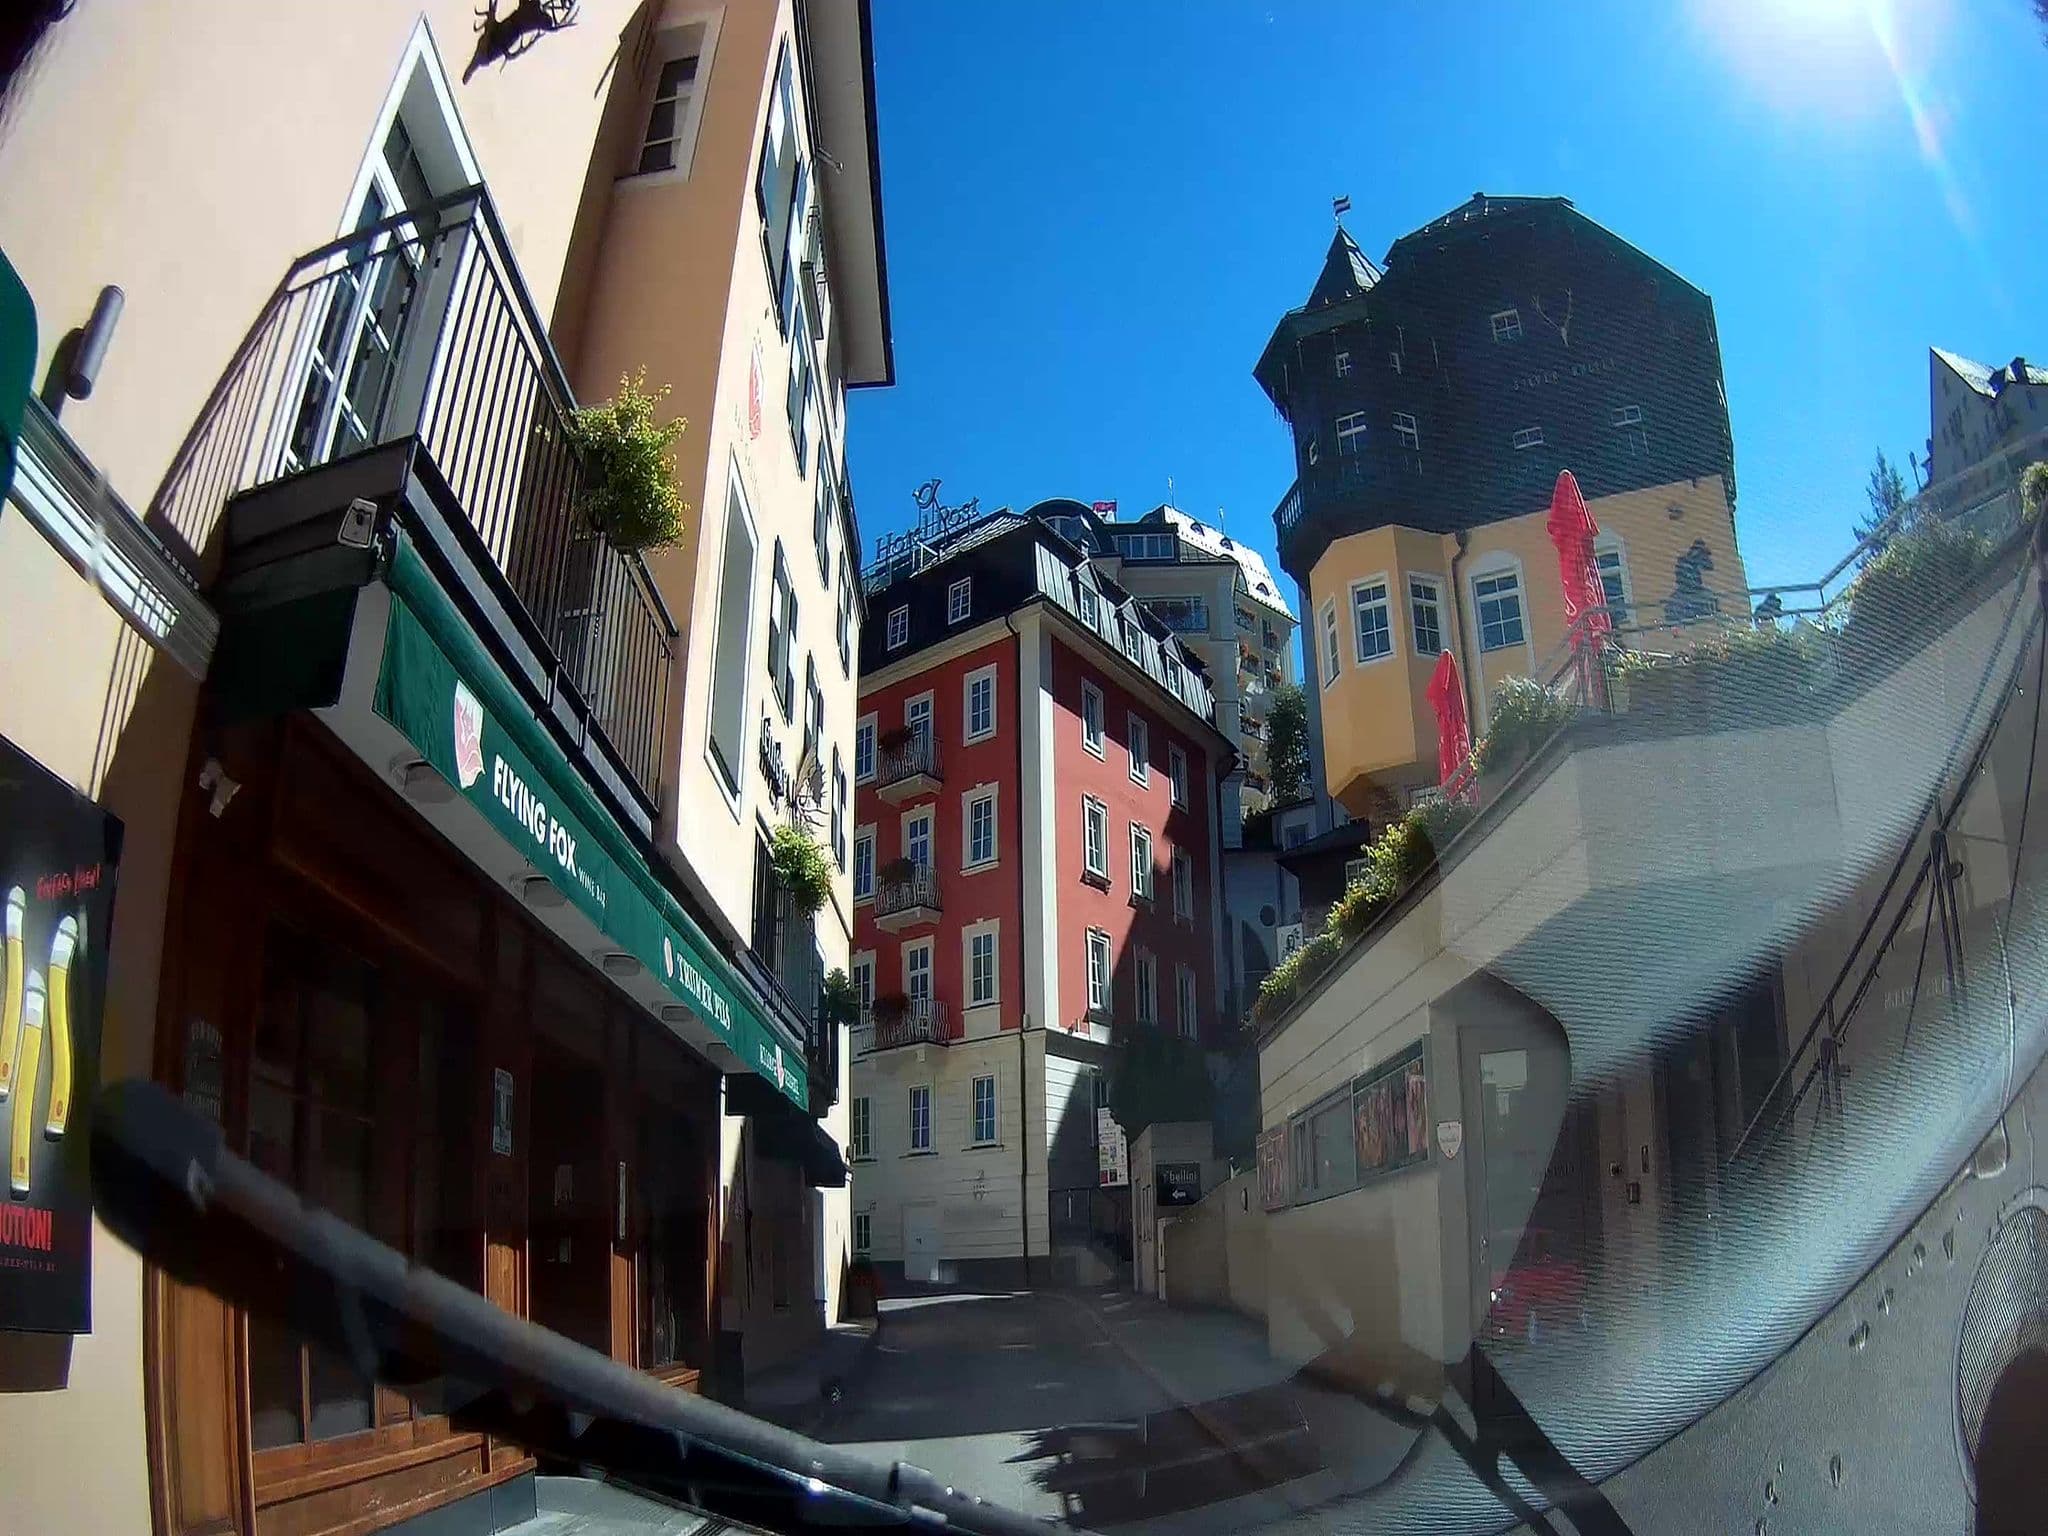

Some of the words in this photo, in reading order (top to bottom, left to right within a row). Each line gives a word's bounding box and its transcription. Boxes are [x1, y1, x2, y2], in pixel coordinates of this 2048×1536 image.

[875, 512, 931, 562] Hotel
[938, 496, 980, 528] Post
[493, 753, 547, 845] FLYING
[549, 816, 578, 878] FOX
